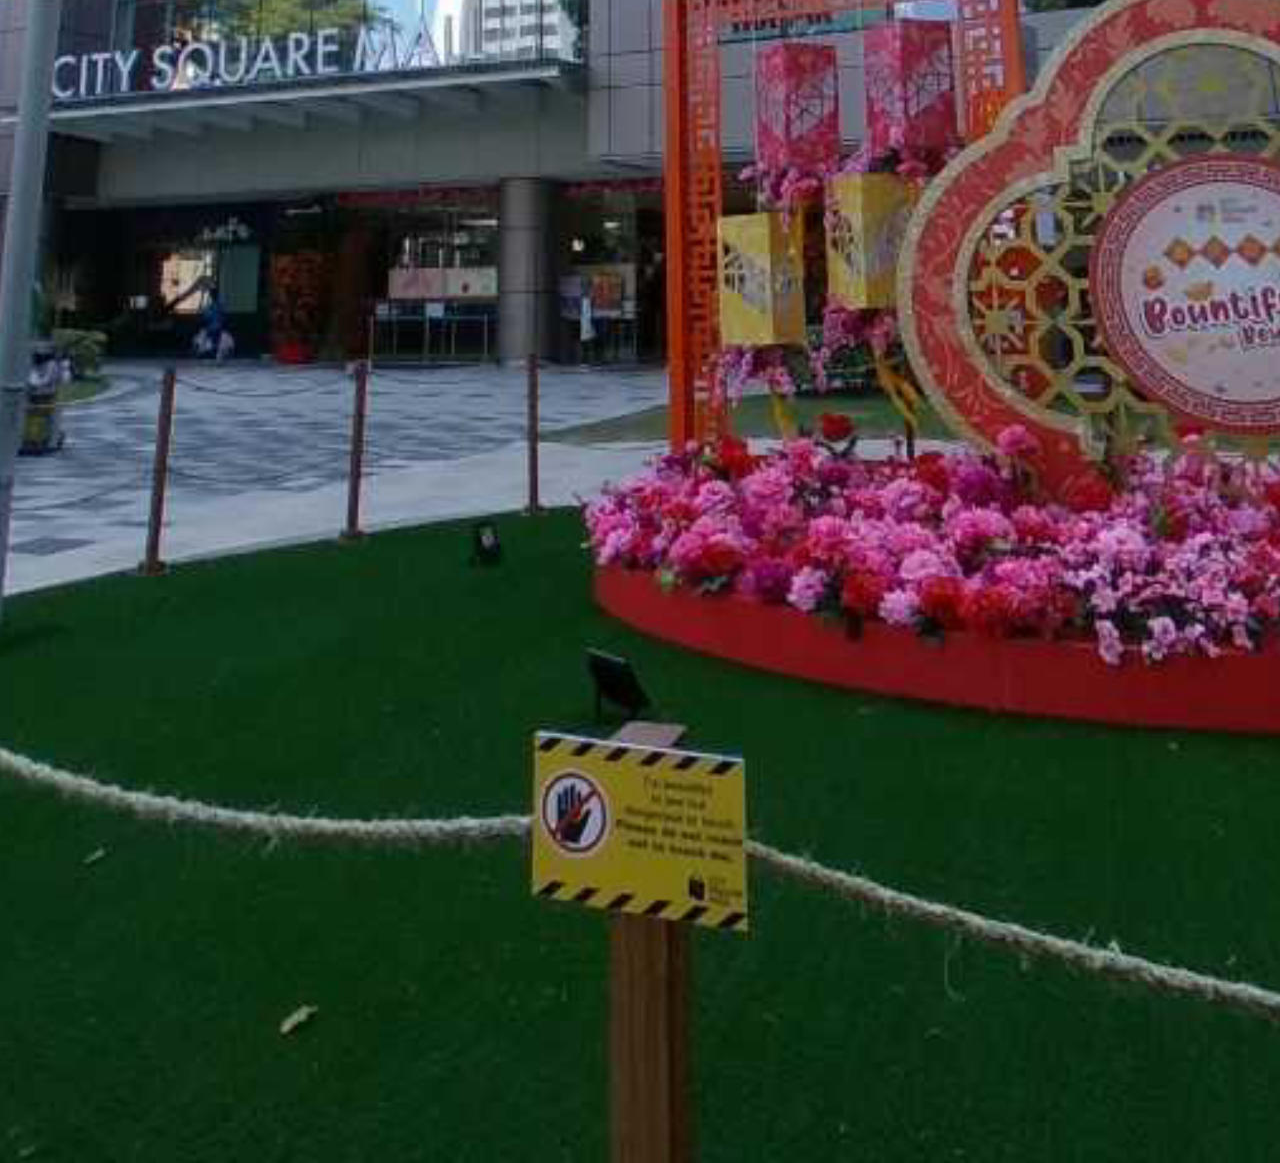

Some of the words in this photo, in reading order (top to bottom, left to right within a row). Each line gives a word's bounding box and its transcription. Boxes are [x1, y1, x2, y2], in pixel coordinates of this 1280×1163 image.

[51, 49, 138, 99] CITY
[150, 27, 339, 91] SQUARE
[353, 14, 490, 72] MAL
